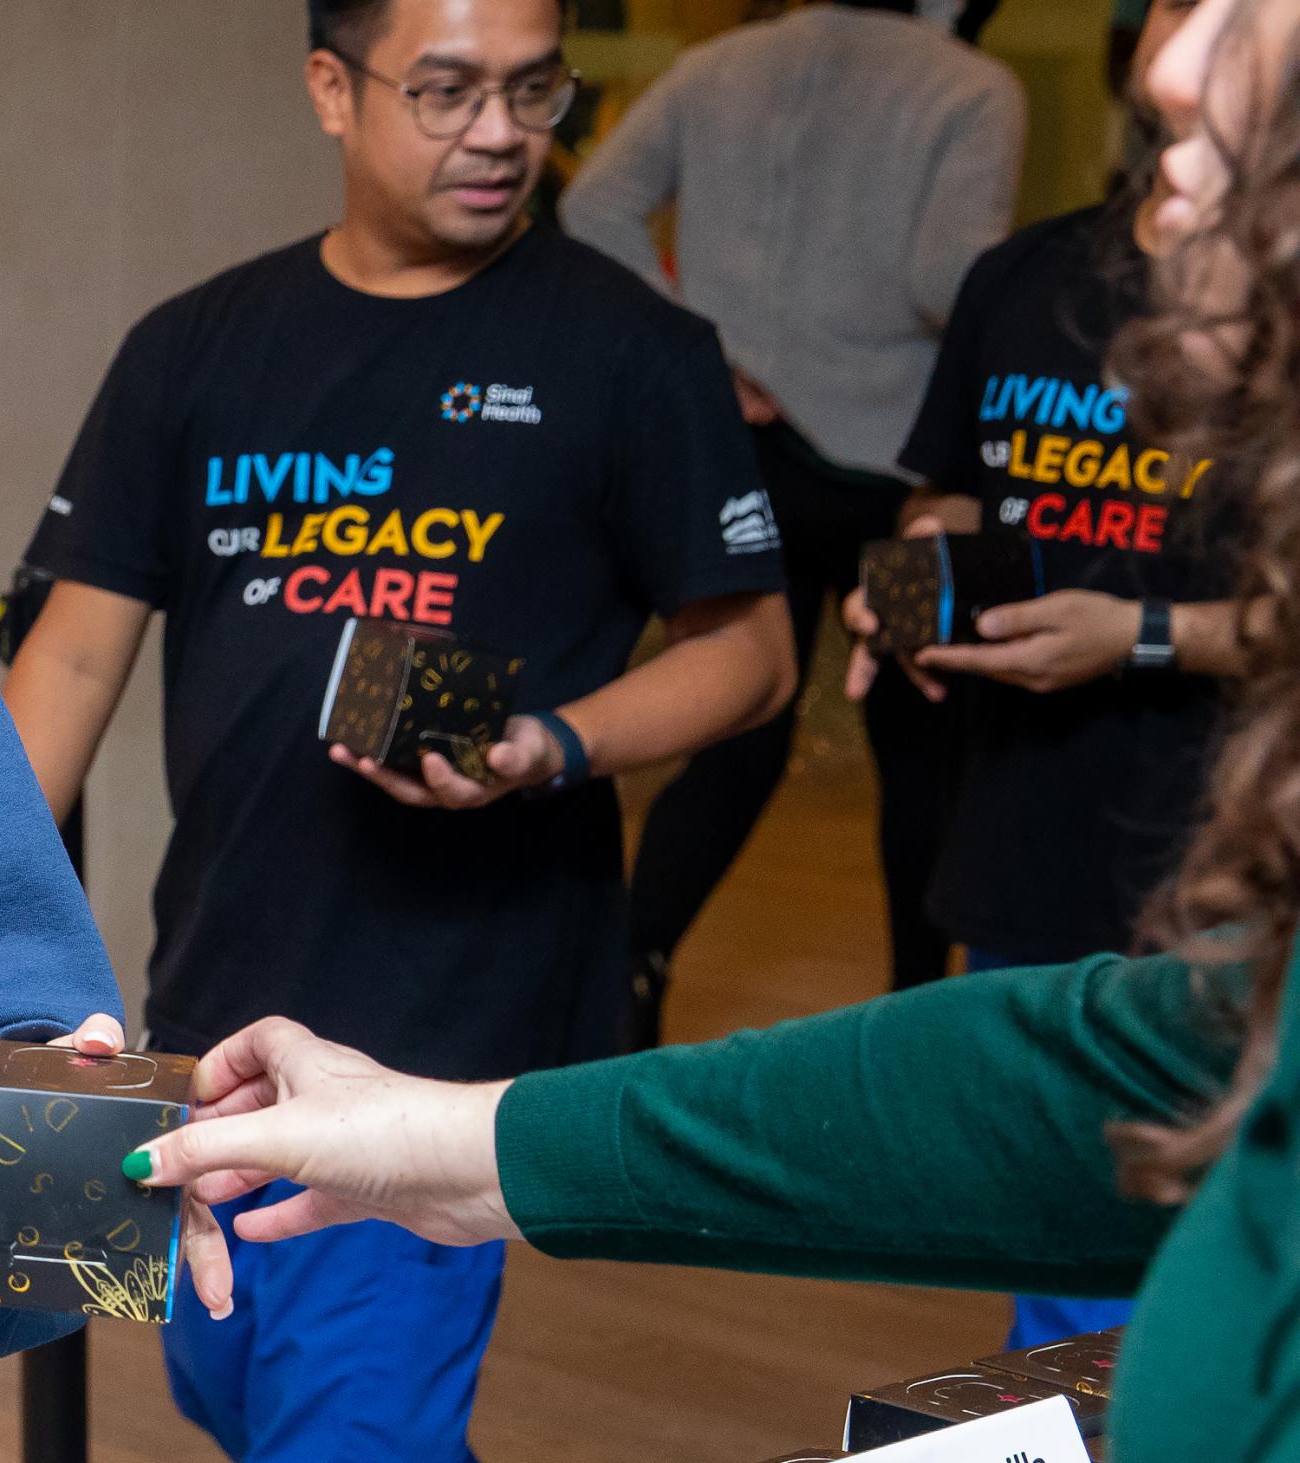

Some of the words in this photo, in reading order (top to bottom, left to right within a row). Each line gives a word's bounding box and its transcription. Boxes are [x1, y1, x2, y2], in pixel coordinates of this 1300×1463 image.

[480, 402, 542, 425] Health
[485, 383, 533, 405] Sinai
[979, 373, 1130, 434] LIVING
[205, 447, 395, 506] LIVING
[208, 526, 260, 557] OUR
[260, 504, 505, 562] LEGACY
[1027, 492, 1168, 553] CARE
[243, 577, 281, 606] OF
[284, 565, 459, 625] CARE
